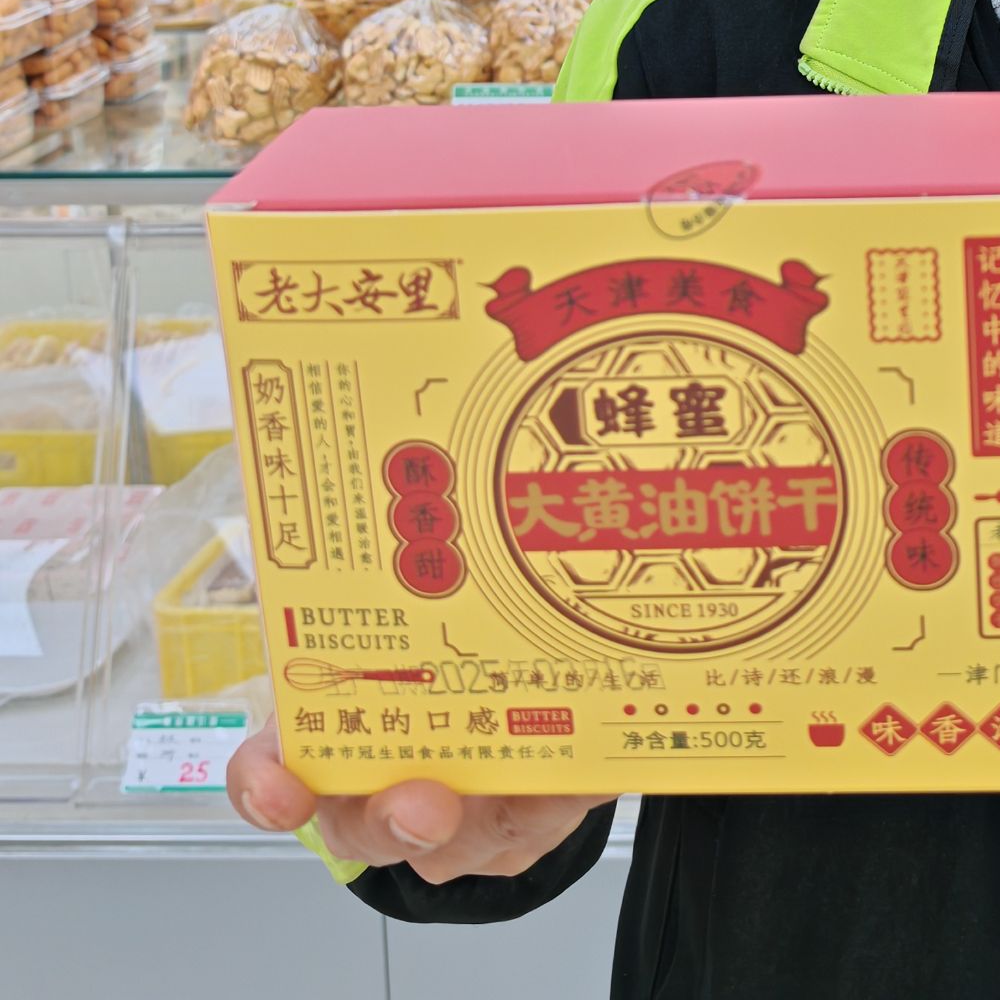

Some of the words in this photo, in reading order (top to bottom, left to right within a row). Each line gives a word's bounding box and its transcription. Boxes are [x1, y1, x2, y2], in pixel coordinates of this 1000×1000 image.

[553, 268, 766, 327] 天津美食
[593, 382, 729, 438] 蜂蜜
[253, 373, 308, 551] 奶香味十足
[403, 456, 446, 580] 酥香甜
[508, 476, 838, 542] 大黄油饼干
[904, 441, 940, 572] 传统味
[300, 607, 409, 626] BUTTER
[631, 603, 692, 618] SINCE
[699, 602, 739, 617] 1930
[304, 633, 410, 650] BISCUITS
[294, 702, 499, 736] 细腻的口感
[512, 710, 571, 722] BUTTER
[513, 723, 571, 734] BISCUITS
[301, 744, 576, 760] 天津市冠生园食品有限责任公司
[179, 760, 210, 783] 25
